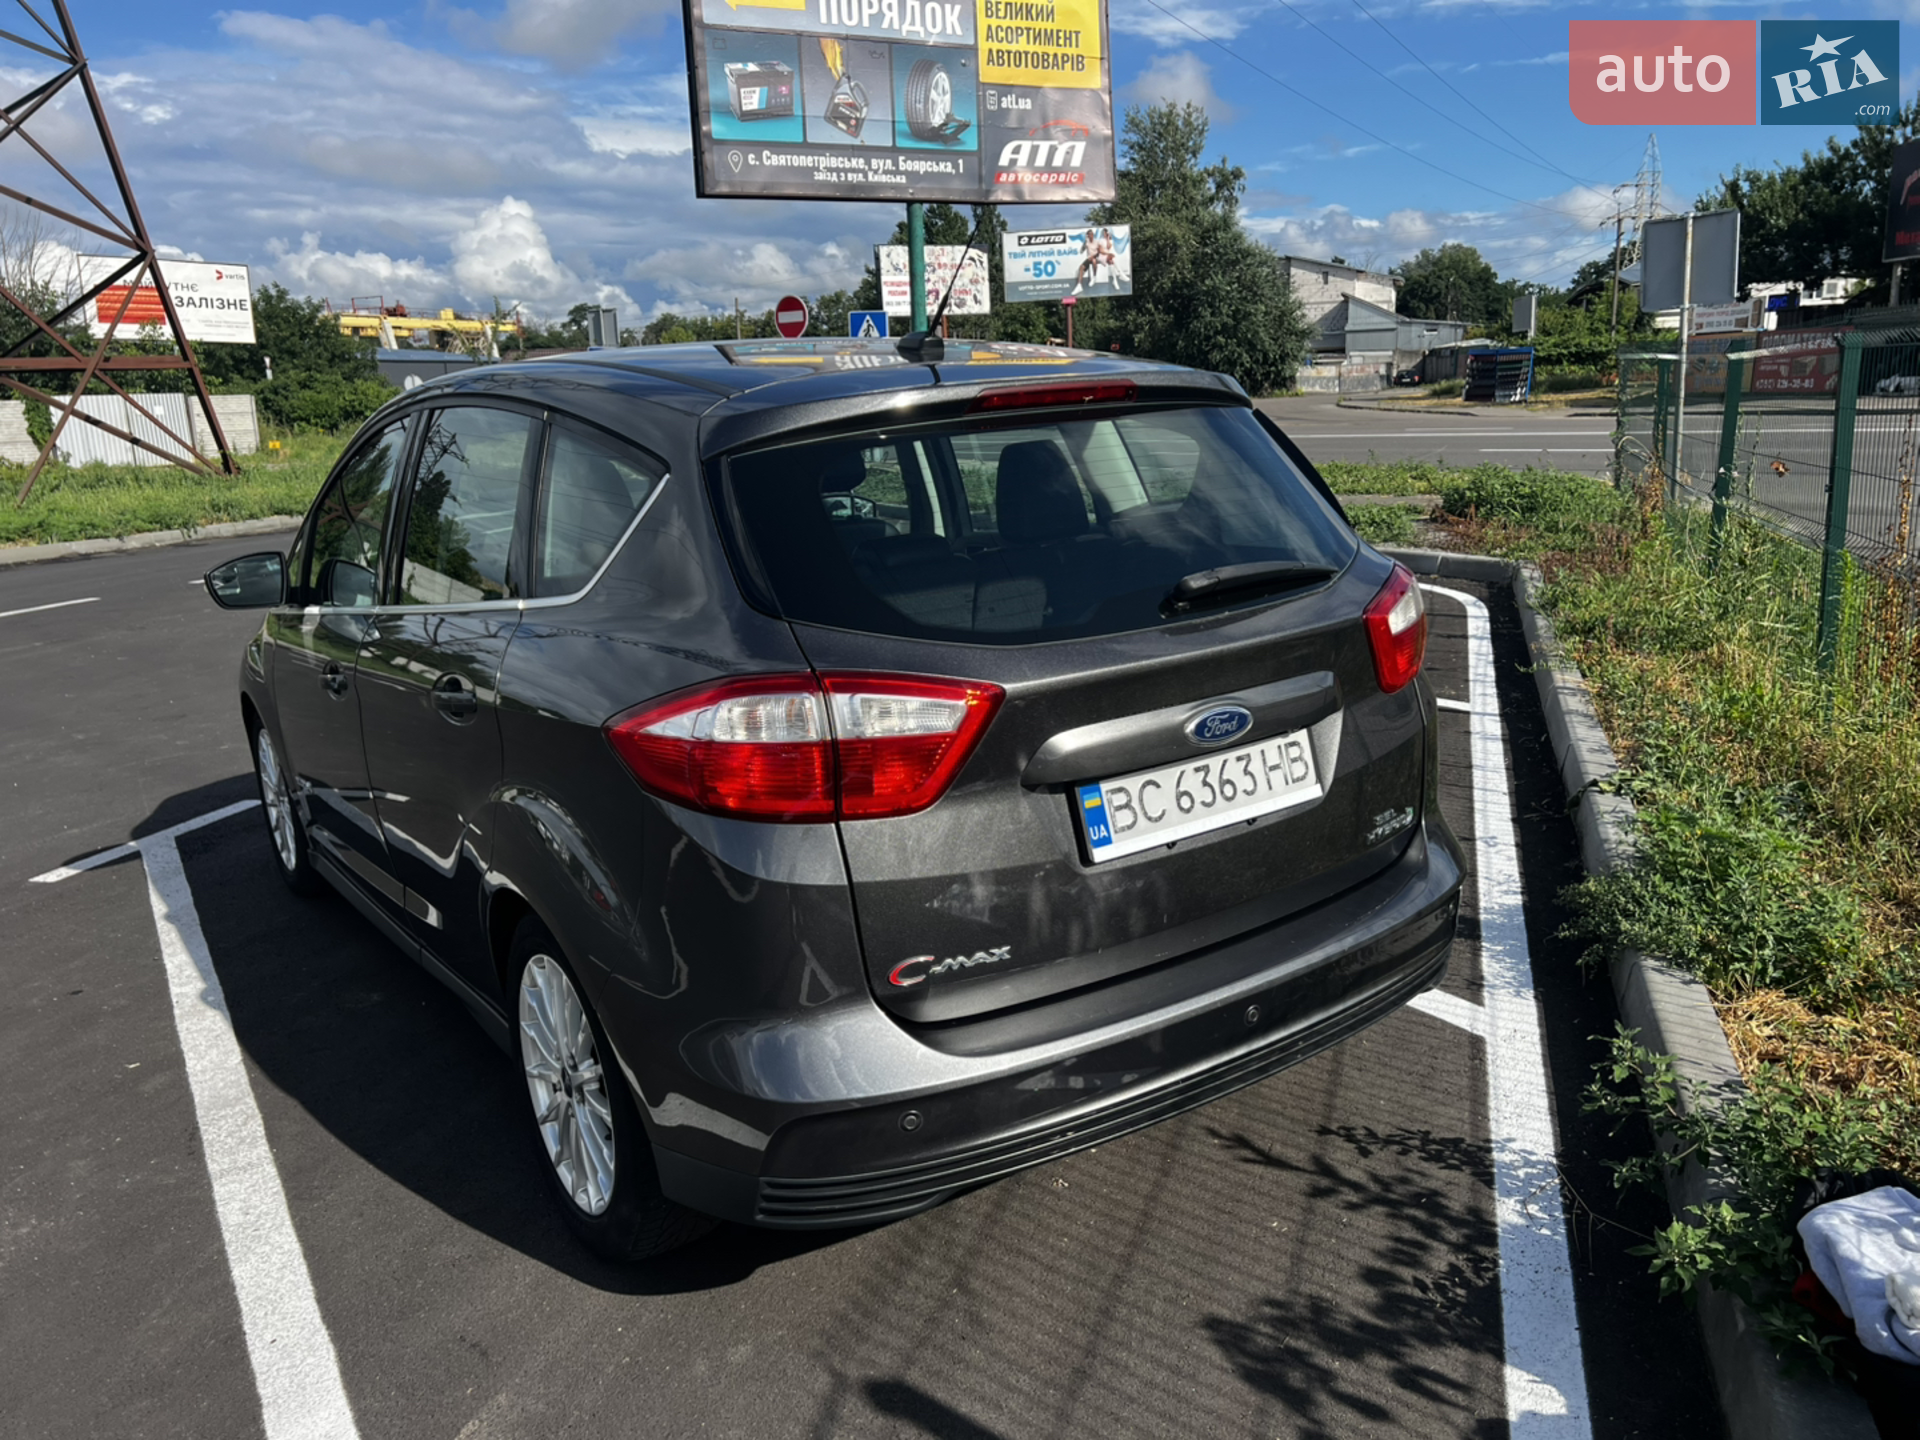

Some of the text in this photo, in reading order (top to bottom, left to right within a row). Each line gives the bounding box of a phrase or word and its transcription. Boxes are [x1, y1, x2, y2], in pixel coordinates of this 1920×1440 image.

[819, 0, 963, 37] ПОРЯДОК
[984, 0, 1055, 23] ВЕЛИКИЙ
[985, 24, 1081, 49] АСОРТИМЕНТ
[986, 48, 1086, 72] АВТОТОВАРІВ
[1000, 93, 1032, 110] atl.ua
[762, 150, 869, 171] Святопетрівське,
[871, 158, 896, 173] вул.
[899, 156, 956, 174] Боярська,
[958, 159, 964, 173] 1
[999, 171, 1079, 184] автосервіс
[1030, 234, 1064, 244] LOTTO
[174, 295, 249, 311] ЗАЛІЗНЕ
[1204, 713, 1239, 737] Ford
[1106, 741, 1309, 834] BC 6363 HB
[1089, 825, 1109, 840] UA
